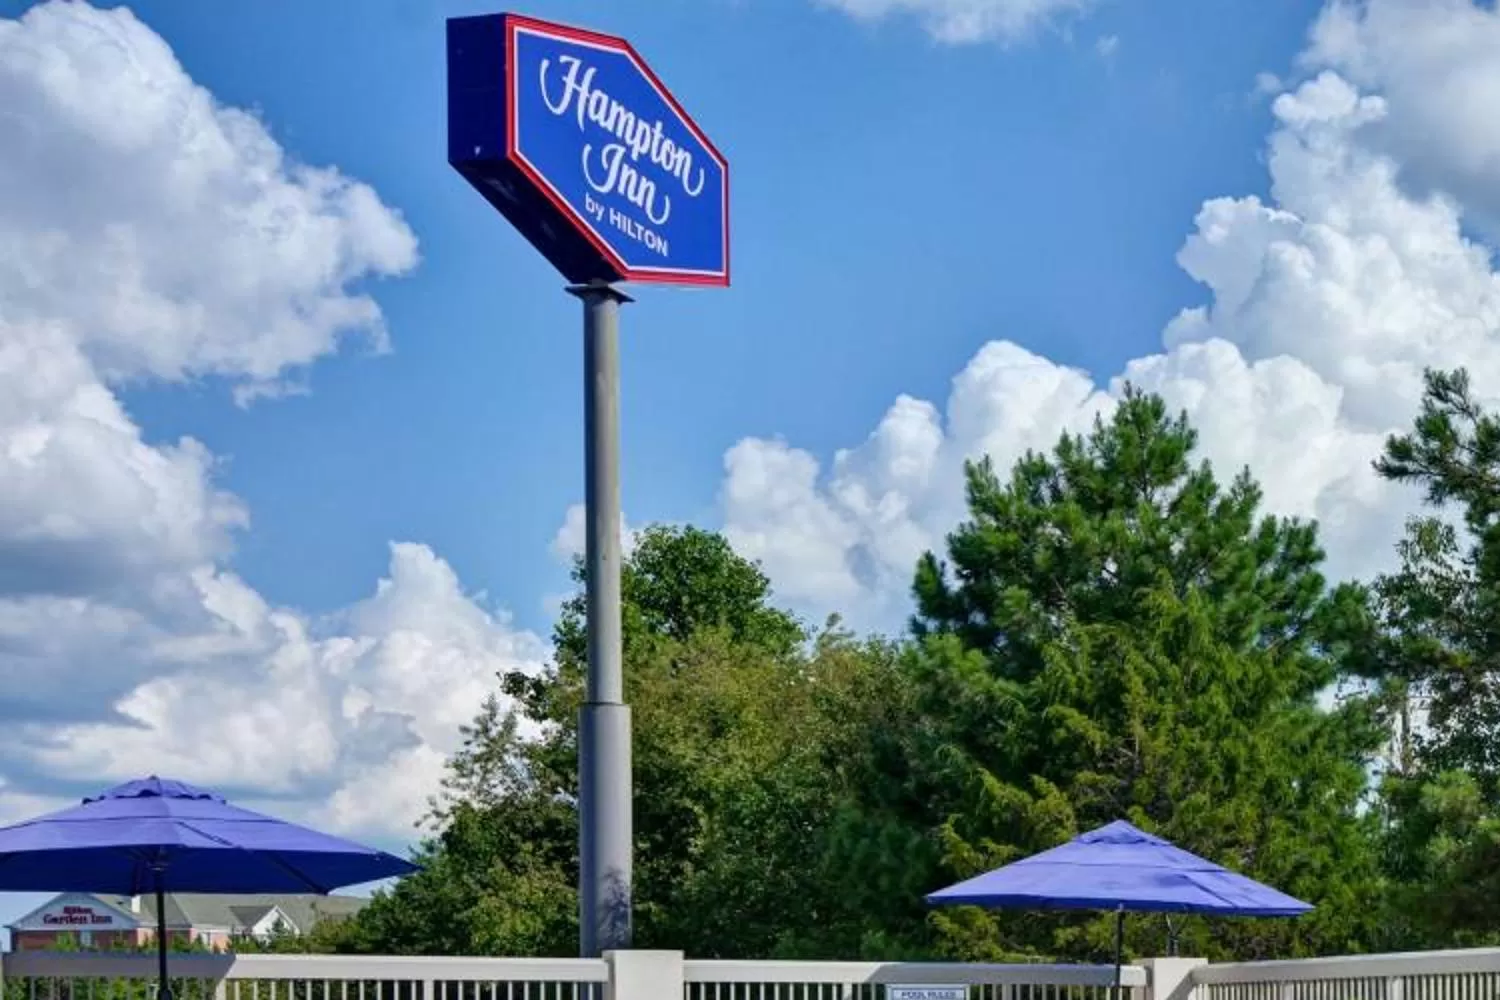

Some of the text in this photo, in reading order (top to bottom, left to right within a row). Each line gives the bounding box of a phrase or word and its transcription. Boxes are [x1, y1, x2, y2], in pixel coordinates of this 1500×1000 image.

[540, 55, 704, 197] Hampton
[583, 144, 670, 224] Inn
[610, 209, 668, 257] HILTON
[43, 913, 112, 924] Garden Inn
